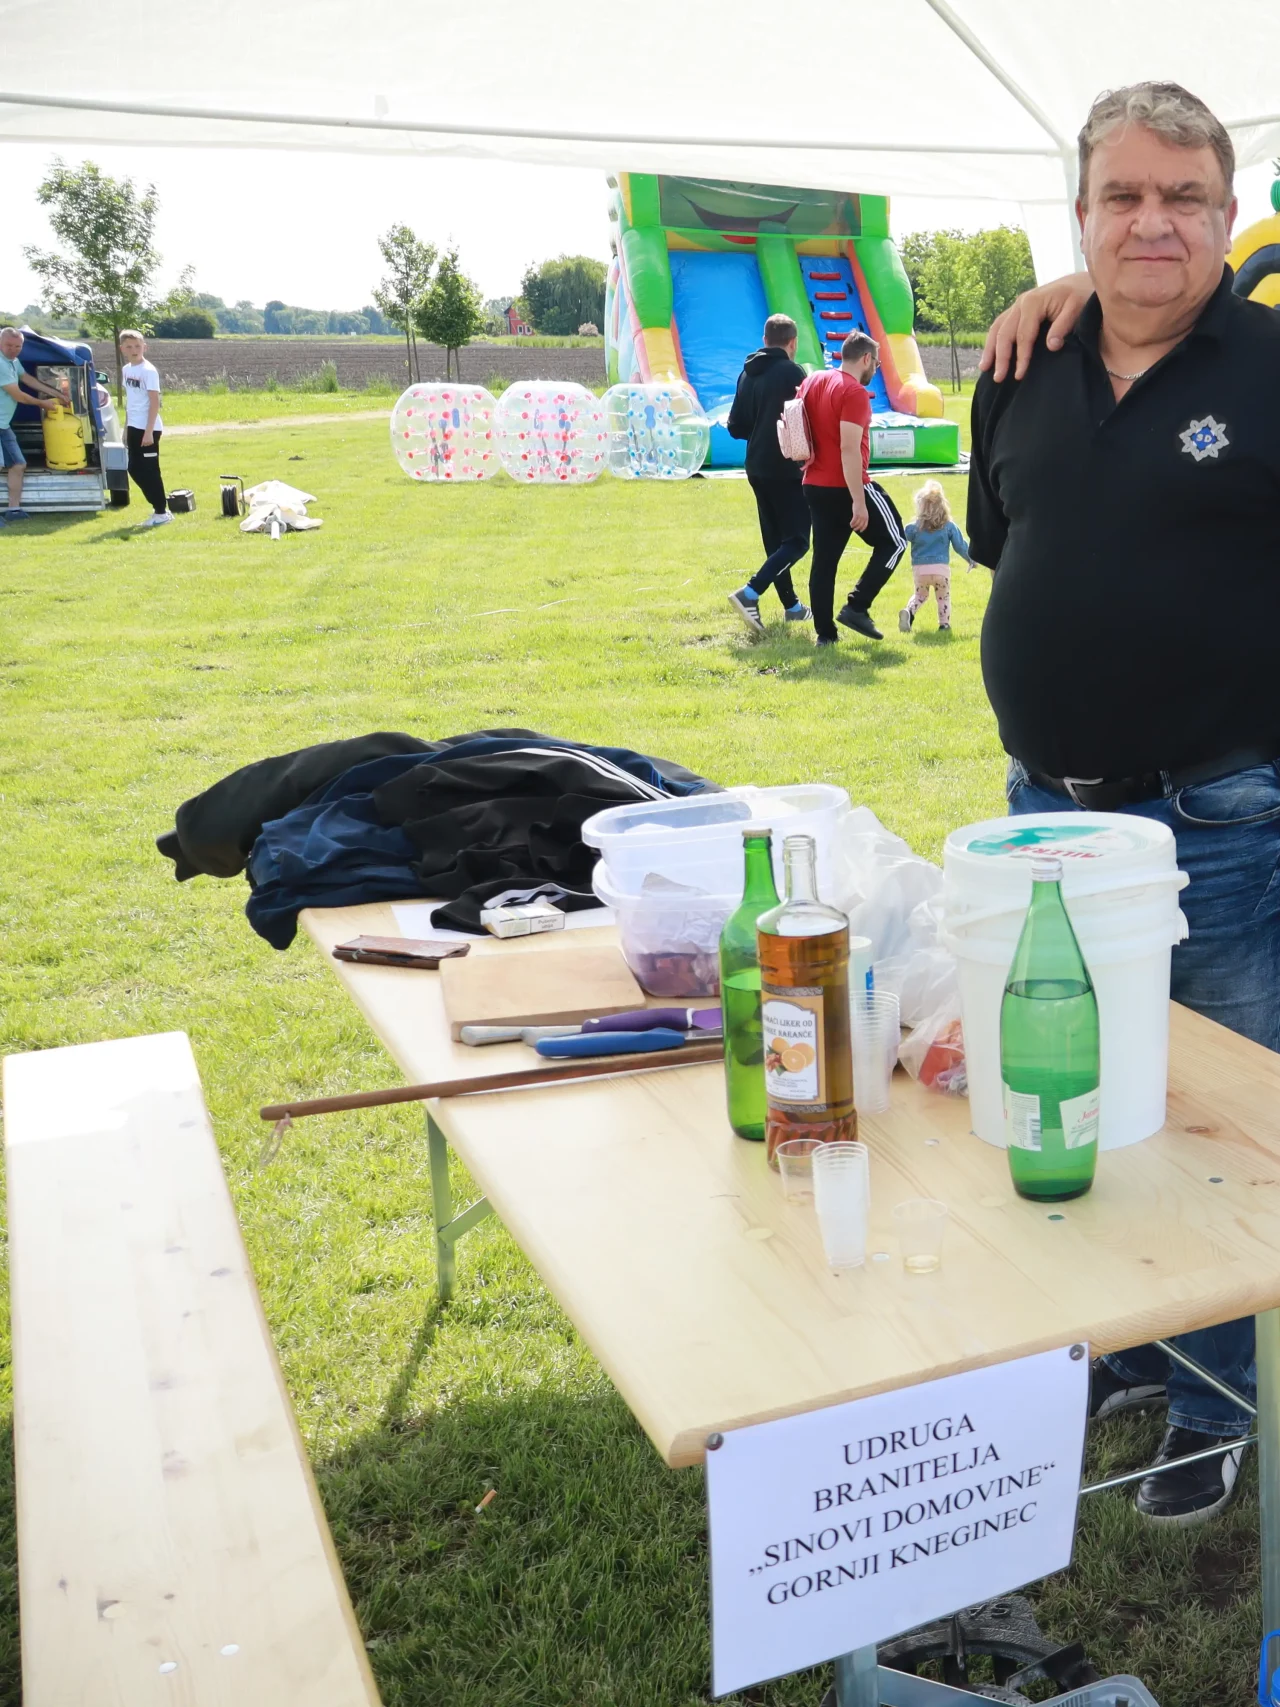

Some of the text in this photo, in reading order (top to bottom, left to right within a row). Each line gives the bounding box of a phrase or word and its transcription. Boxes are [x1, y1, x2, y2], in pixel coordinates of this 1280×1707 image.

[779, 1018, 801, 1028] LIKER
[802, 1020, 813, 1028] OD
[842, 1413, 976, 1466] UDRUGA
[812, 1443, 1001, 1514] BRANITELJA
[766, 1502, 1039, 1606] GORNJI KNEGINEC
